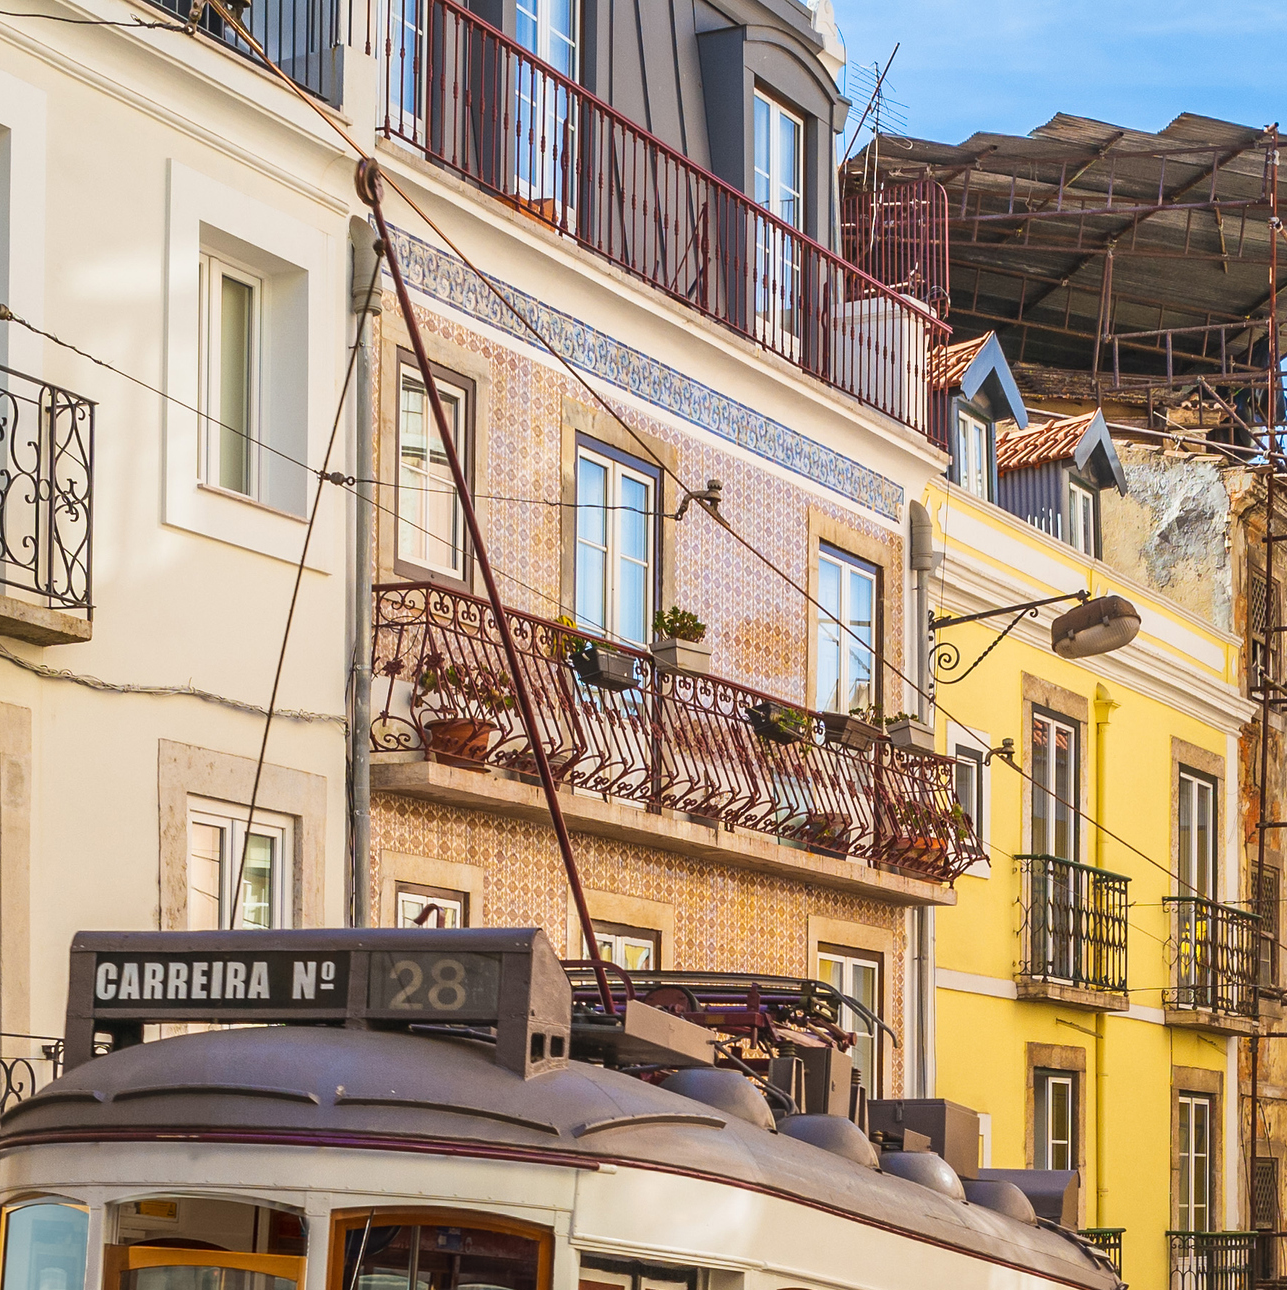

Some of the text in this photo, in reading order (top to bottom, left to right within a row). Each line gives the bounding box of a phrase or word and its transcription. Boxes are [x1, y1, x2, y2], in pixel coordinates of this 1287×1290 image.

[95, 959, 467, 1012] CARREIRA Nº 28
